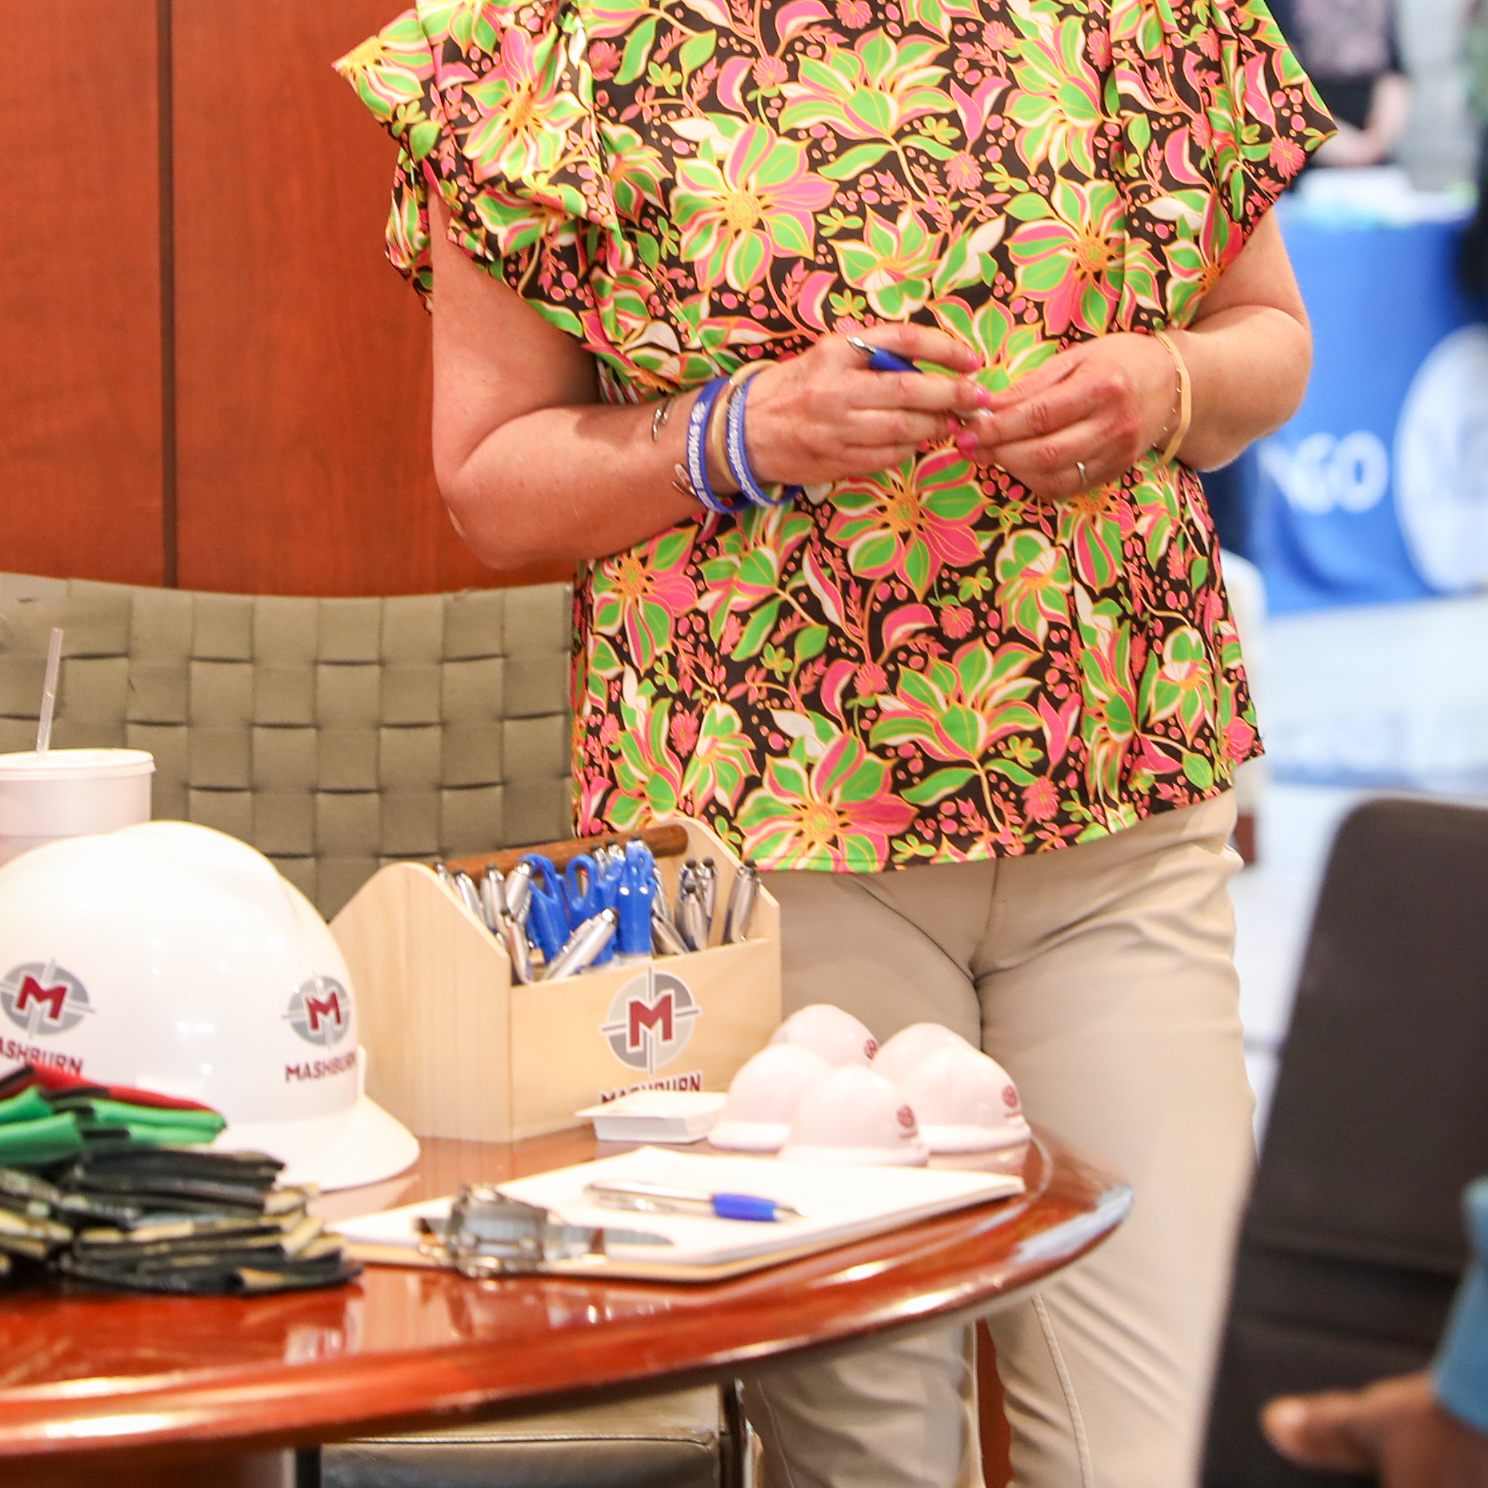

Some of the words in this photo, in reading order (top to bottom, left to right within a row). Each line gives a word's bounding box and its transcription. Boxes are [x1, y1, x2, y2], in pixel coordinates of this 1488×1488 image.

[16, 974, 68, 1021] M
[305, 991, 341, 1031] M
[628, 993, 673, 1048] M
